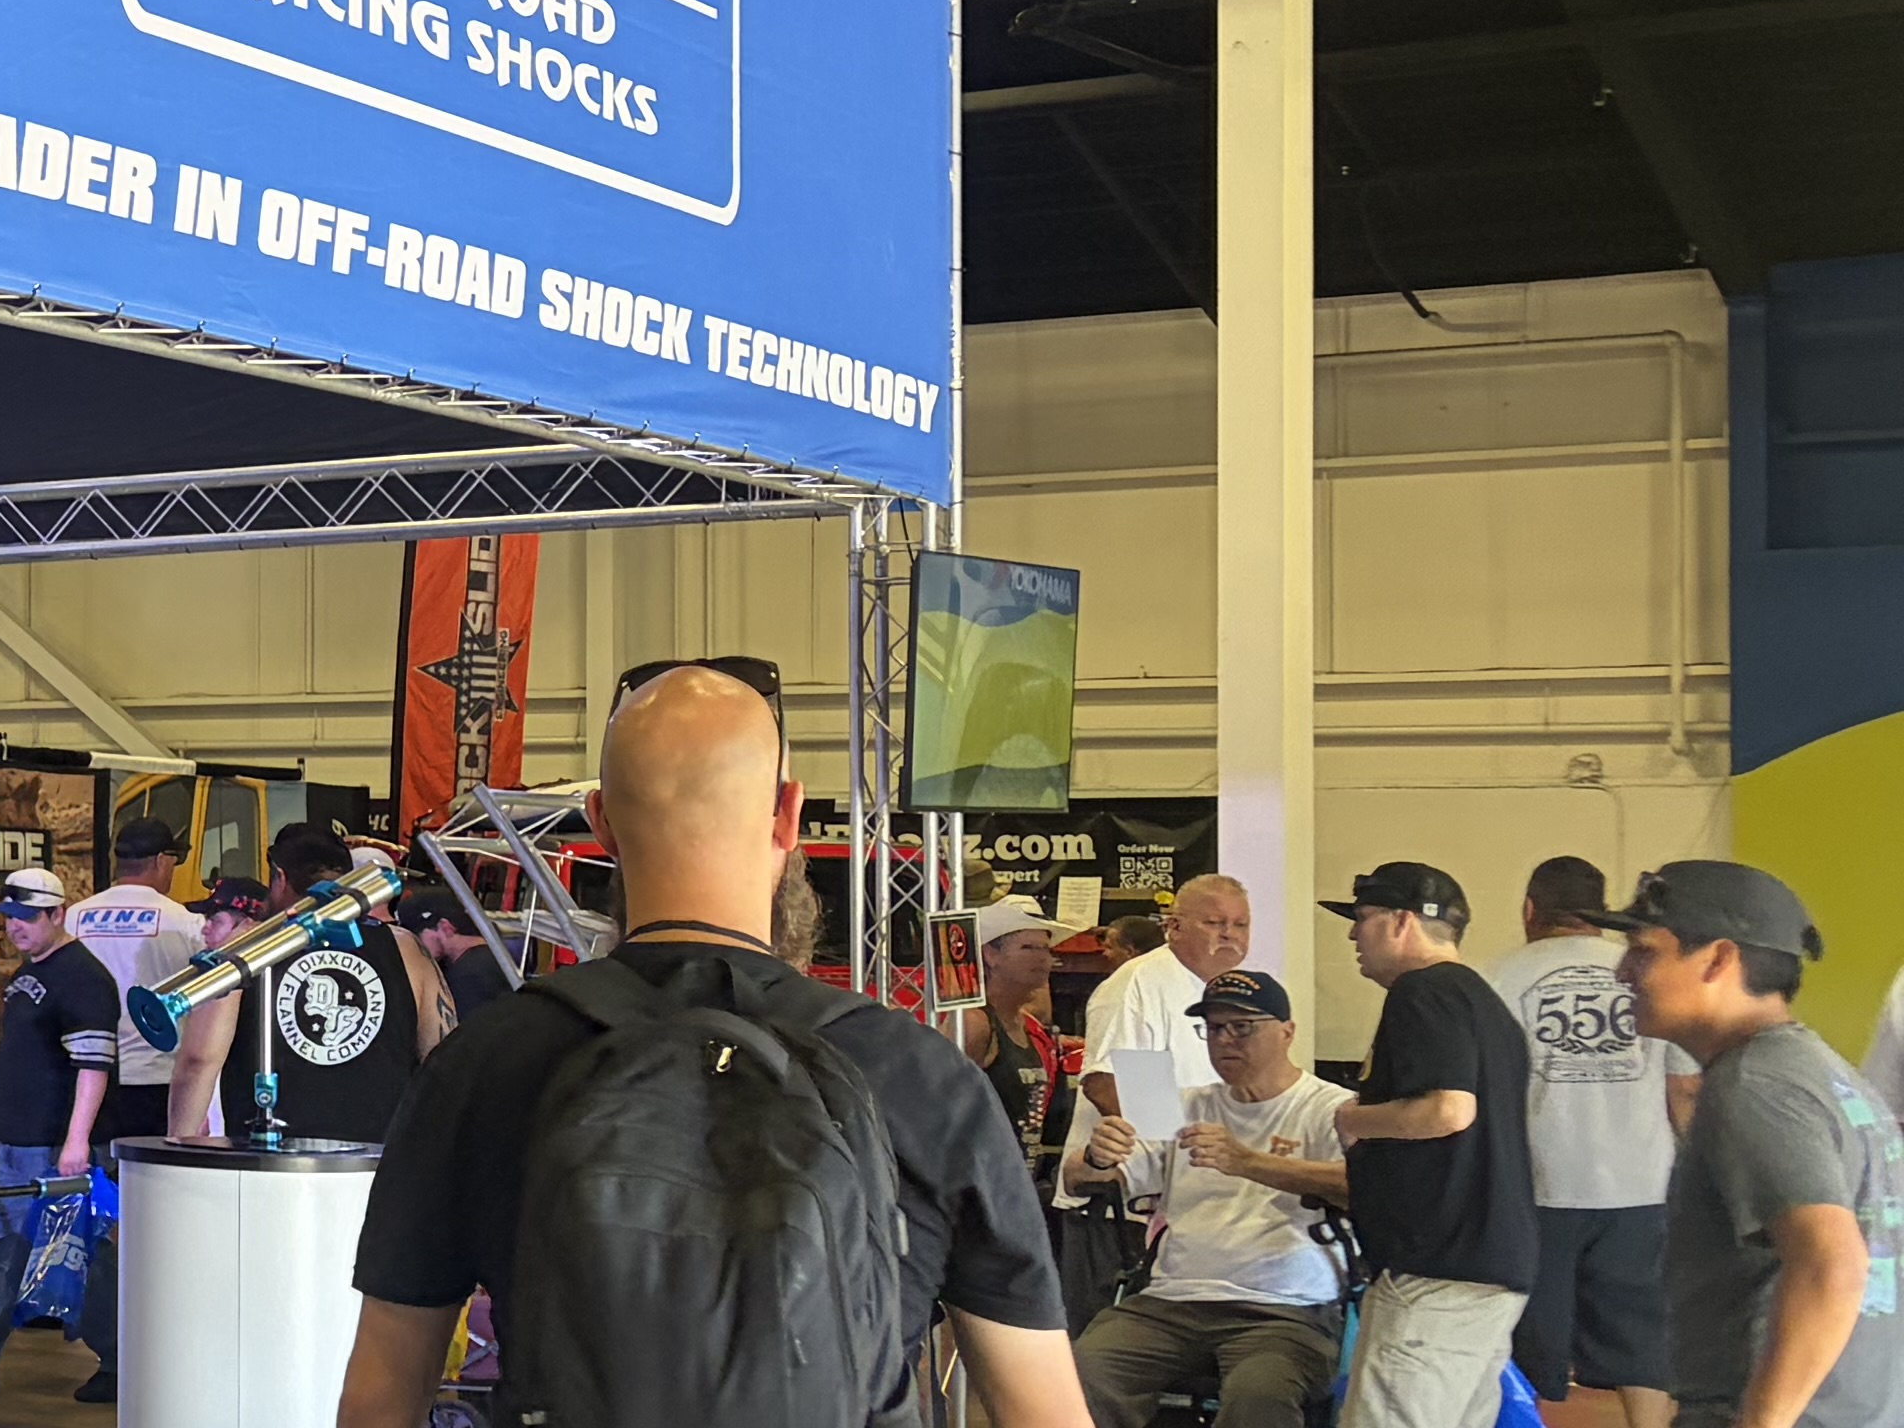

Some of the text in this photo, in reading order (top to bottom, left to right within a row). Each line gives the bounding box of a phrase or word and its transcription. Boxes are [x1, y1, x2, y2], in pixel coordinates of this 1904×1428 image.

[465, 19, 660, 136] SHOCKS
[174, 166, 242, 246] IN
[258, 188, 526, 321] OFF-ROAD
[539, 269, 693, 367] SHOCK
[703, 317, 939, 435] TECHNOLOGY
[465, 535, 497, 636] SLID
[1118, 844, 1175, 854] Order Now
[80, 909, 157, 925] KING
[297, 952, 368, 976] DIXXON
[278, 982, 383, 1062] FLANNEL COMPANY
[1536, 992, 1637, 1044] 556
